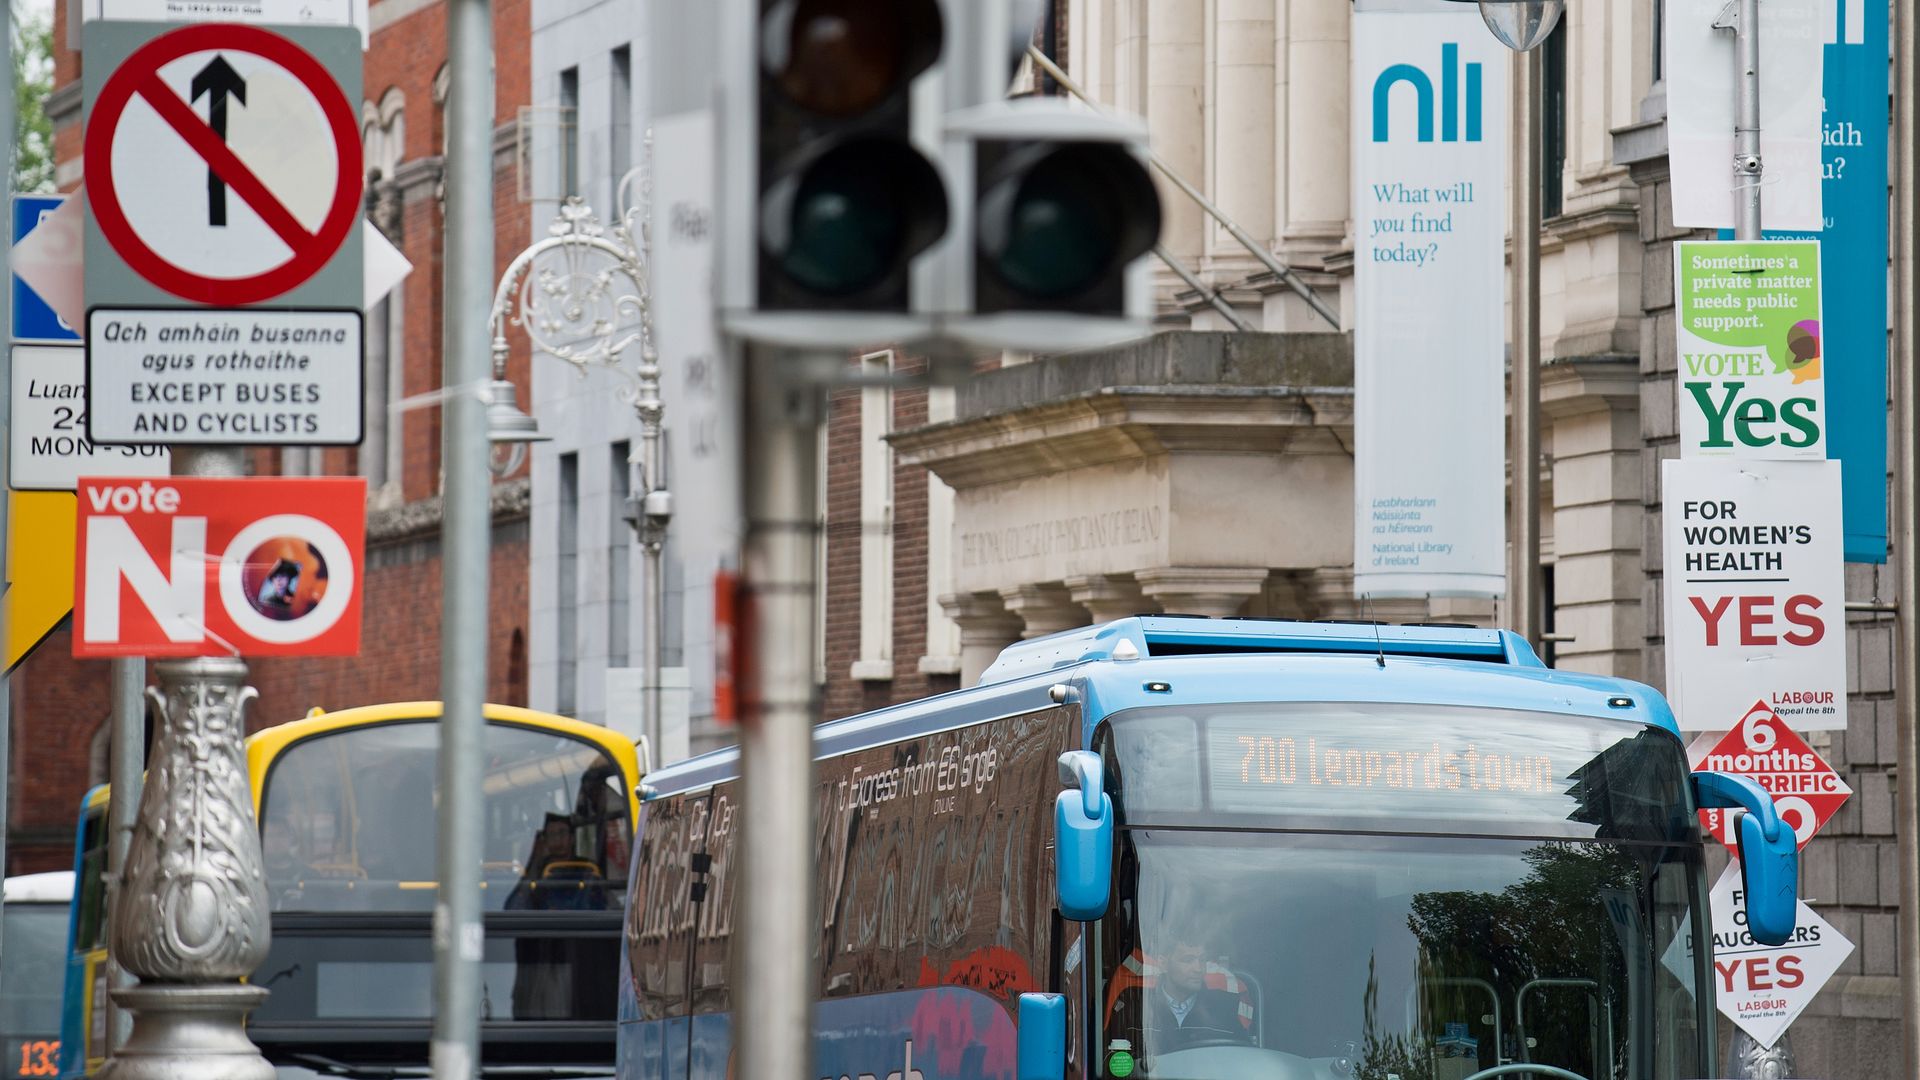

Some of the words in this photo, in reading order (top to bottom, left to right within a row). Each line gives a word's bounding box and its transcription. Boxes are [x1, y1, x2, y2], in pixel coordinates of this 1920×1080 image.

[1373, 182, 1430, 203] What
[1435, 182, 1474, 203] will
[1370, 218, 1405, 238] you
[1411, 212, 1452, 233] find
[1373, 242, 1438, 267] today?
[1692, 254, 1784, 269] Sometimes
[1692, 274, 1752, 292] private
[1757, 275, 1813, 289] matter
[1692, 294, 1741, 309] needs
[1746, 293, 1798, 312] public
[104, 321, 147, 342] Ach
[251, 324, 346, 343] busanna
[1693, 314, 1764, 332] support.
[142, 352, 194, 374] agus
[205, 350, 310, 370] rothaithe
[1683, 353, 1765, 377] VOTE
[131, 383, 225, 402] EXCEPT
[237, 383, 320, 402] BUSES
[134, 413, 187, 433] AND
[197, 413, 318, 433] CYCLISTS
[1684, 382, 1820, 448] Yes
[31, 436, 94, 455] MON
[87, 481, 181, 514] vote
[1372, 497, 1437, 508] Leabharlann
[1683, 500, 1737, 520] FOR
[1372, 525, 1385, 534] na
[1683, 525, 1812, 545] WOMEN’S
[1372, 543, 1415, 553] National
[1418, 543, 1453, 555] Library
[1372, 556, 1382, 566] of
[1385, 556, 1419, 566] Ireland
[1685, 551, 1783, 571] HEALTH
[84, 514, 355, 645] NO
[1687, 594, 1826, 647] YES
[1772, 691, 1834, 704] LABOUR
[1773, 706, 1804, 716] Repeal
[1806, 706, 1820, 715] the
[1822, 706, 1836, 715] 8th
[1742, 709, 1777, 753] 6
[1238, 736, 1296, 784] 700
[1309, 737, 1553, 793] Leopardstown
[1707, 748, 1816, 772] months
[849, 766, 899, 816] Express
[902, 755, 936, 798] from
[960, 737, 997, 795] single
[933, 796, 955, 815] ONLINE
[1715, 955, 1804, 993] YES
[1737, 1000, 1787, 1011] LABOUR
[1740, 1012, 1762, 1020] Repeal
